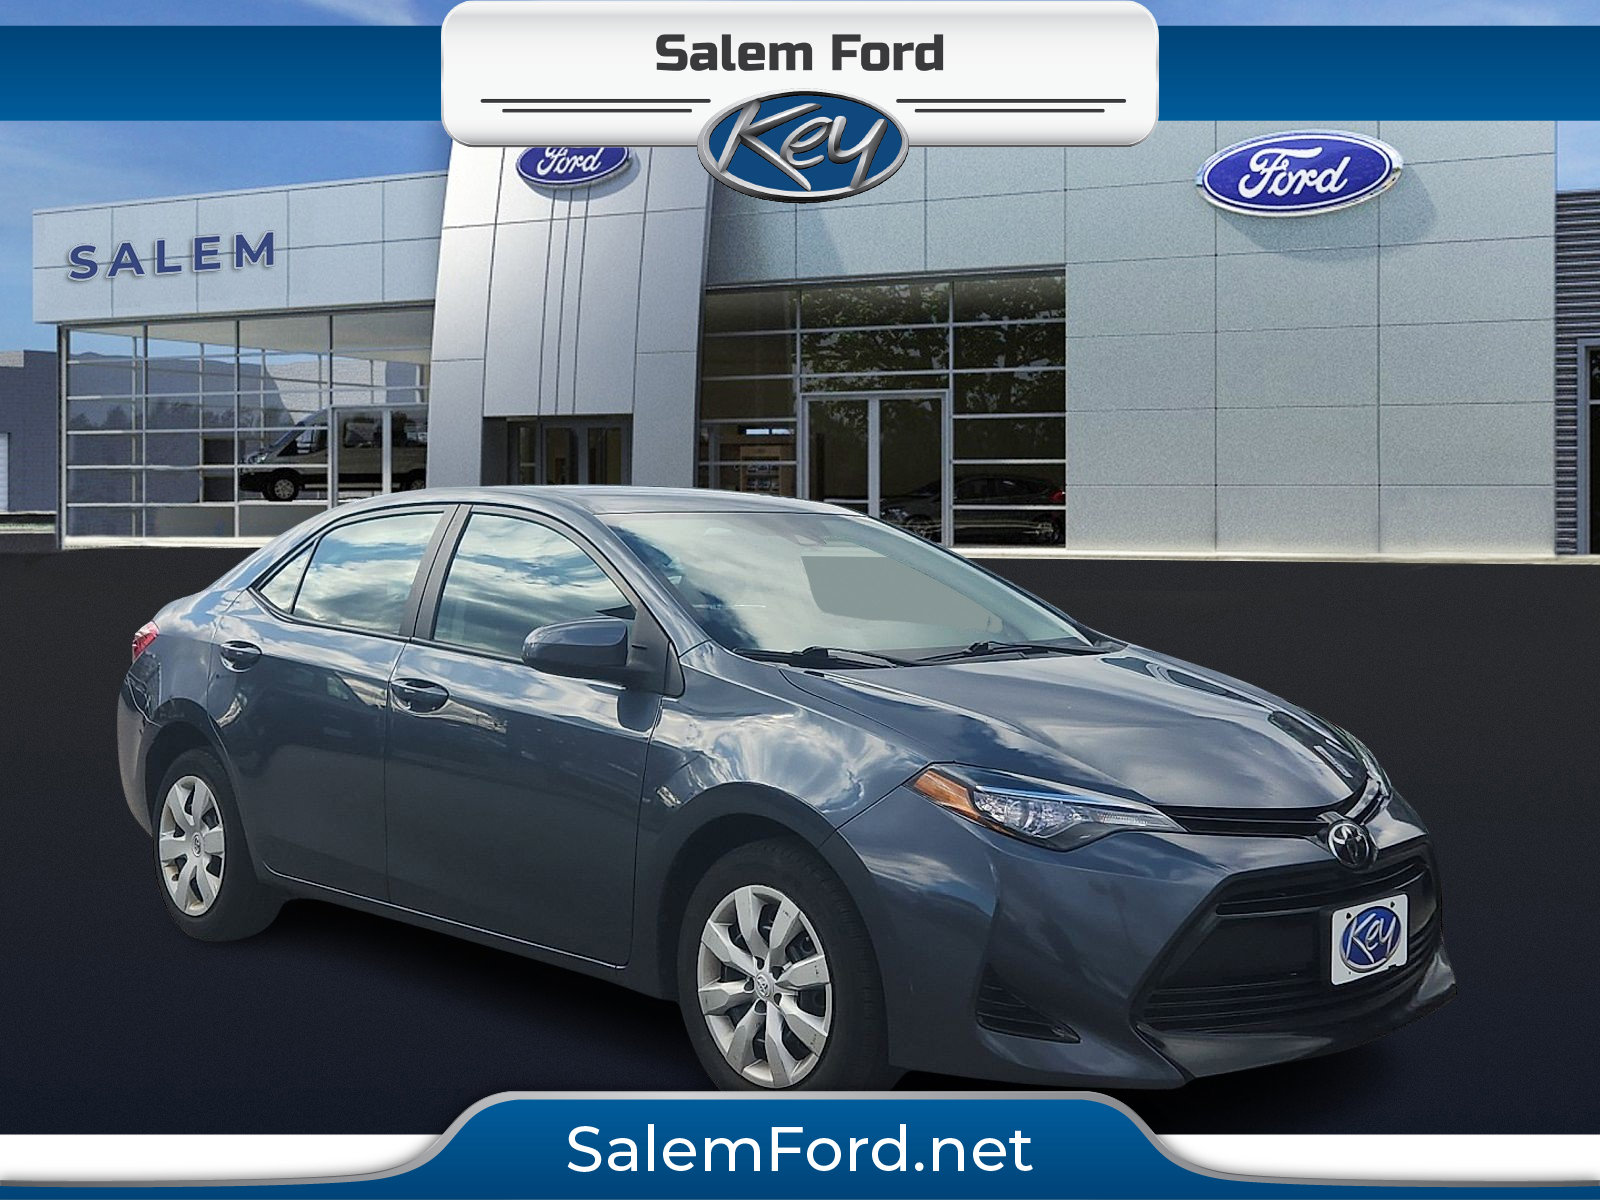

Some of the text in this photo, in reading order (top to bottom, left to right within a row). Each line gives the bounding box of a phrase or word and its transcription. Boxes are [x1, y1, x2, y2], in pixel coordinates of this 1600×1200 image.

[1238, 146, 1351, 199] Ford
[68, 231, 276, 281] SALEM
[1345, 912, 1397, 964] Key
